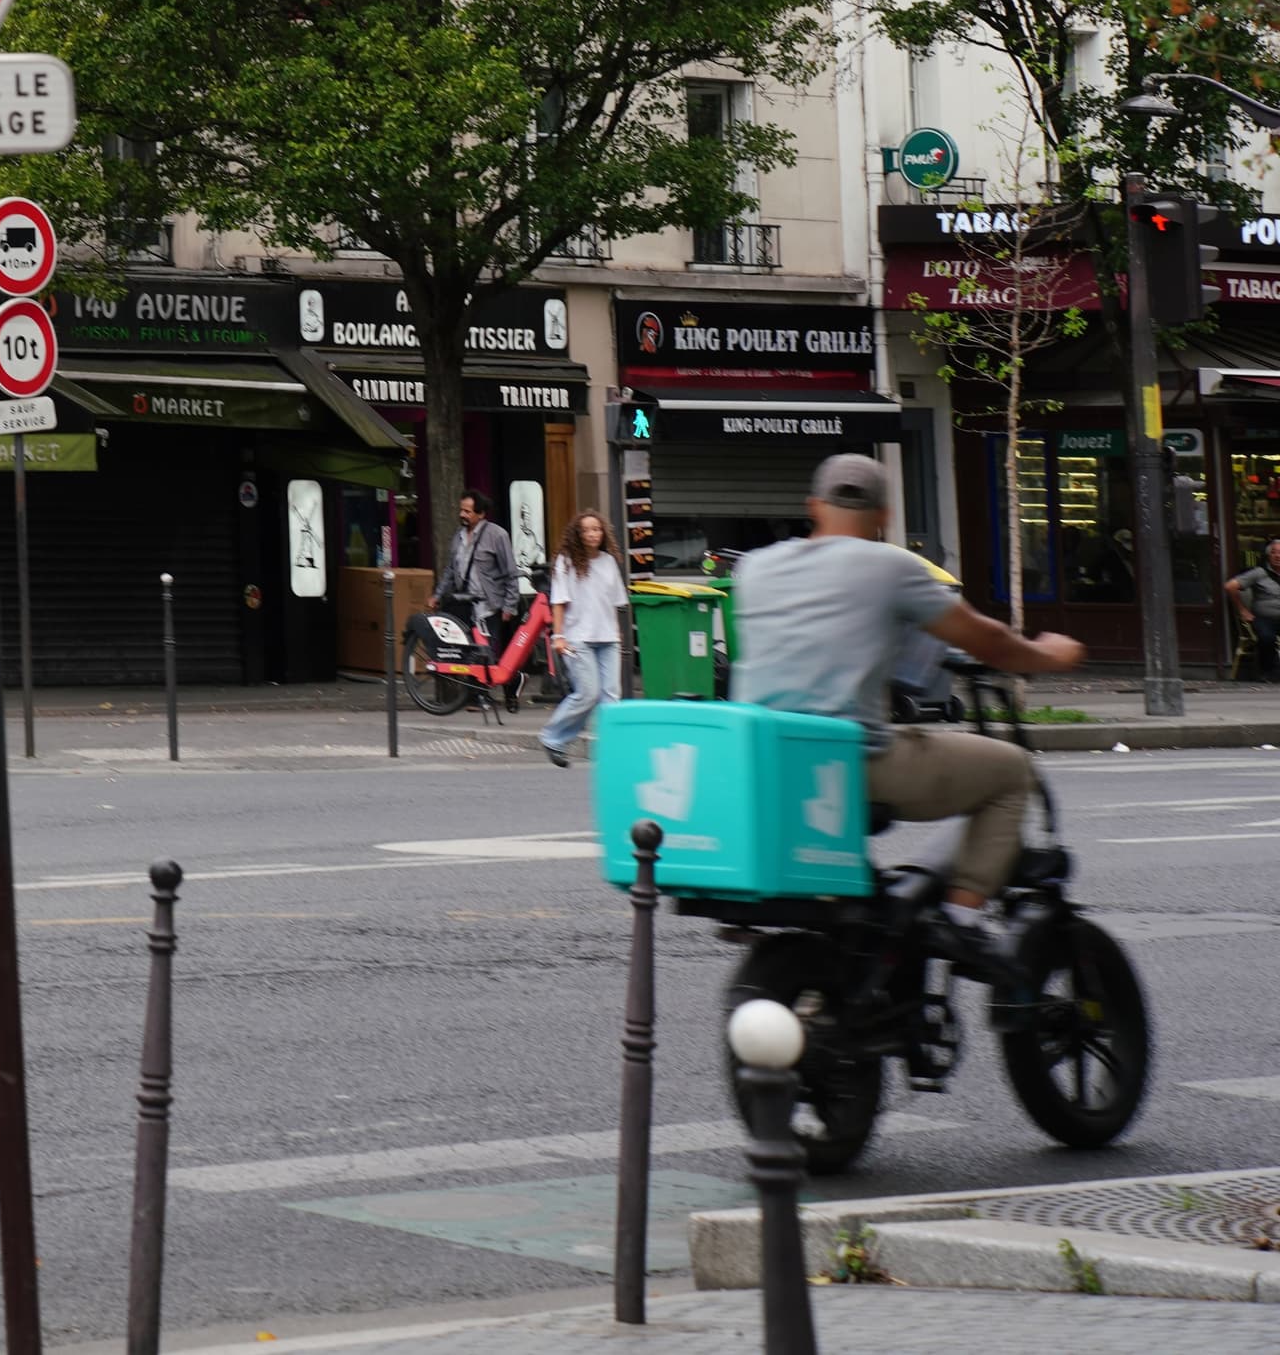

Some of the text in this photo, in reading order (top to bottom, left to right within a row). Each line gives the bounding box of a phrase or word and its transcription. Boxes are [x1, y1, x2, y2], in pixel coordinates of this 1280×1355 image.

[16, 74, 48, 96] LE
[936, 212, 1030, 234] TABAC
[923, 261, 981, 278] LOTO
[949, 287, 1018, 304] TABAC
[136, 294, 246, 323] AVENUE
[674, 326, 872, 354] KING POULET GRILLÉ
[500, 385, 570, 408] TRAITEUR
[10, 404, 37, 414] SAUF
[151, 396, 224, 418] MARKET
[3, 416, 46, 430] SERVICE
[723, 417, 752, 433] KING
[754, 417, 799, 434] POULET
[1061, 433, 1113, 449] Jouez!
